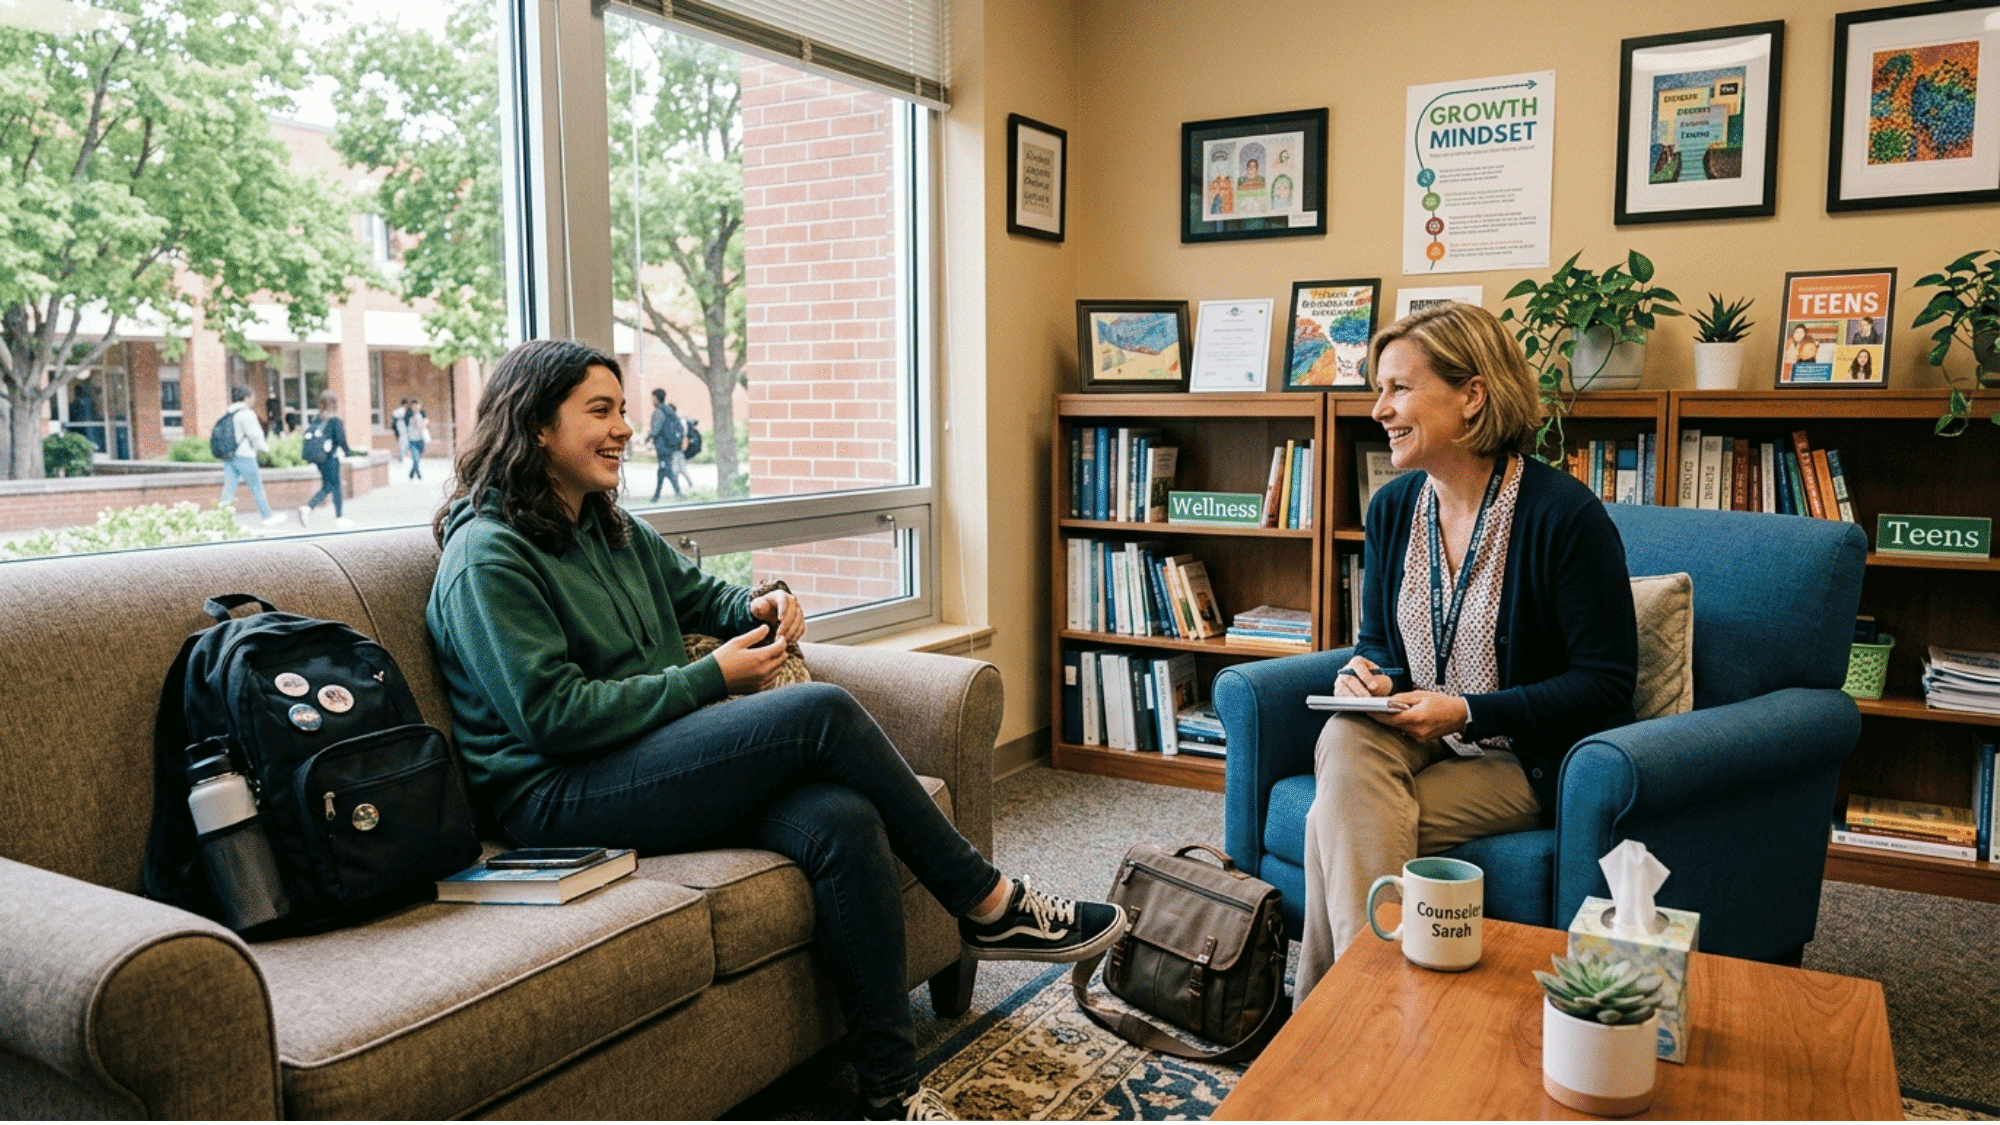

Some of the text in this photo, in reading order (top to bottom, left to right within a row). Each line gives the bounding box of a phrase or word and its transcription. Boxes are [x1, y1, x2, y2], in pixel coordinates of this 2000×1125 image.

[1430, 96, 1538, 126] GROWTH
[1430, 120, 1537, 149] MINDSET
[1798, 291, 1879, 315] TEENS
[1172, 497, 1257, 518] Wellness
[1887, 520, 1980, 548] Teens
[1432, 922, 1472, 938] Sarah
